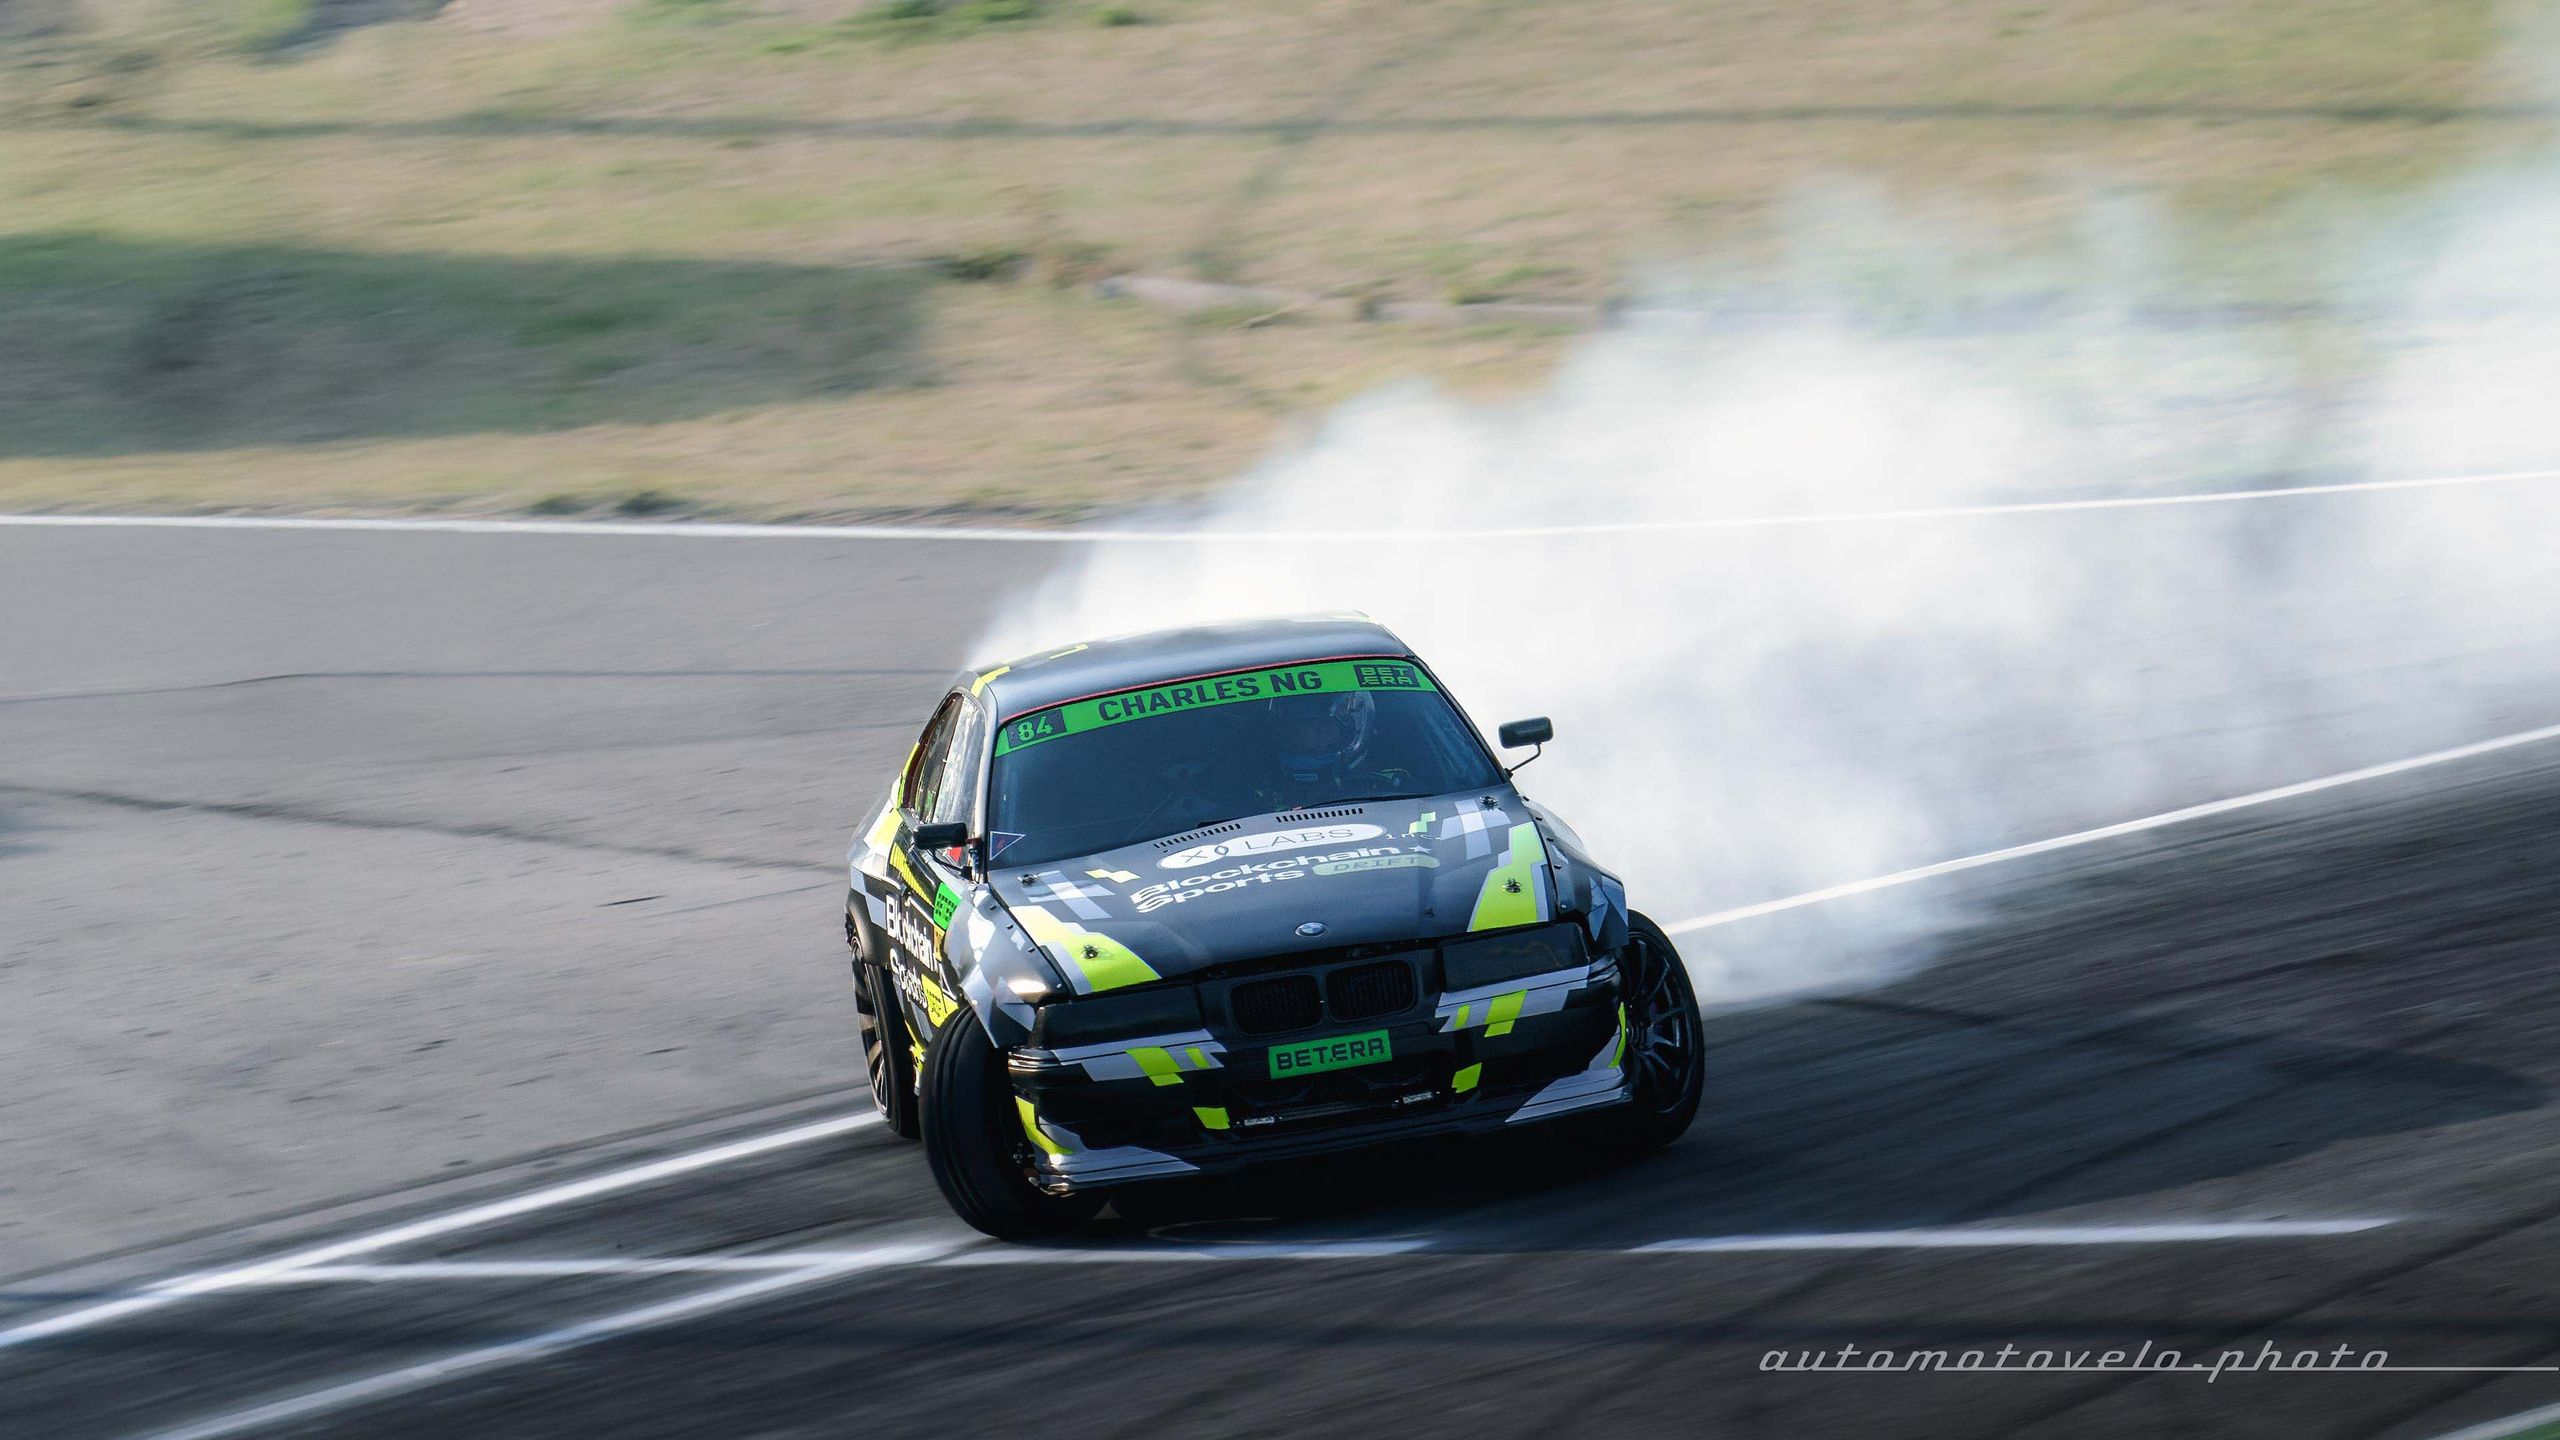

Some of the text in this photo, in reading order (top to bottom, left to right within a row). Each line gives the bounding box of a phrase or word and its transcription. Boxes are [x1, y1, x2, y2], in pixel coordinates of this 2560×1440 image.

[1360, 667, 1408, 676] BET
[1098, 670, 1323, 722] CHARLES NG
[1018, 716, 1053, 742] 84
[1245, 828, 1354, 850] LABS
[1129, 846, 1401, 904] Blockchain
[1333, 857, 1421, 872] DRIFT
[1135, 870, 1305, 914] Sports
[1276, 1037, 1385, 1071] BET.ERA
